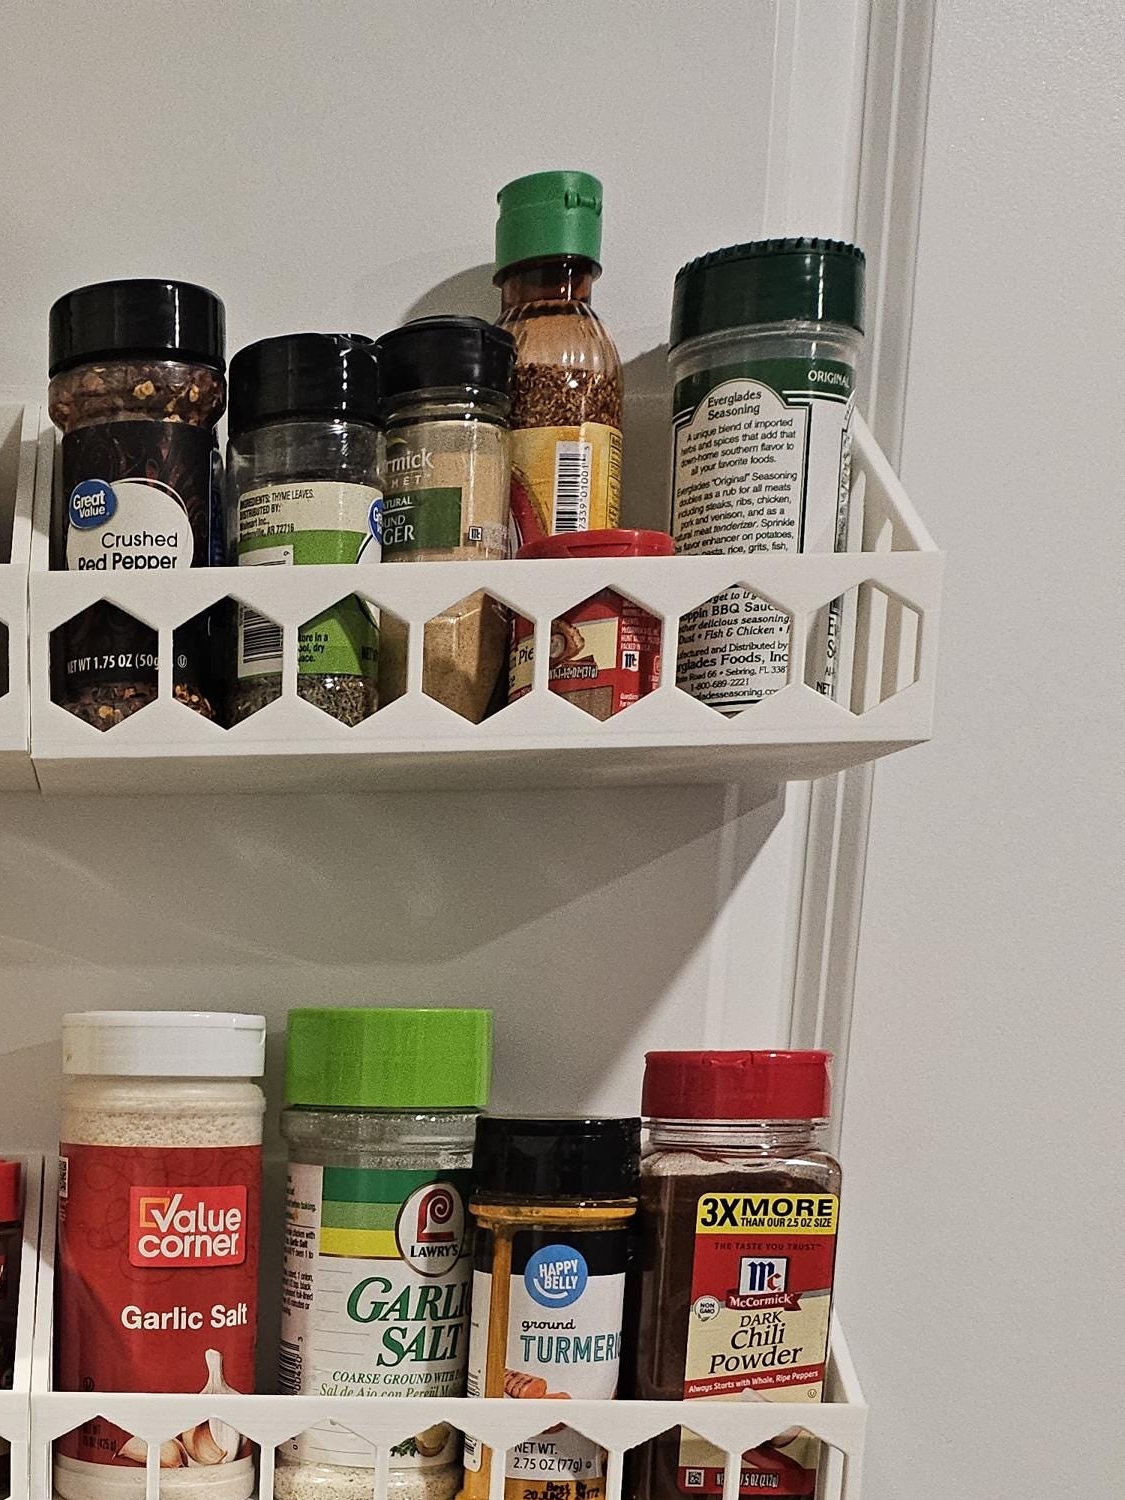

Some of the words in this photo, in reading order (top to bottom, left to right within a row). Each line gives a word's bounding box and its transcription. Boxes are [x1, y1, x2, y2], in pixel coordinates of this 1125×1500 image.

[808, 370, 851, 388] ORIGINAL
[707, 390, 762, 408] Everglades
[708, 404, 760, 421] Seasoning
[754, 419, 793, 429] imported
[721, 445, 758, 458] southern
[761, 442, 784, 452] flavor
[750, 455, 776, 464] foods.
[752, 471, 797, 482] Seasoning
[272, 491, 290, 500] THYME
[292, 490, 314, 500] LEAVES.
[765, 484, 791, 492] meats
[73, 490, 105, 508] Great
[79, 505, 105, 517] Value
[713, 520, 759, 533] tenderizer.
[761, 519, 795, 529] Sprinkle
[102, 533, 178, 548] Crushed
[79, 554, 107, 570] Red
[112, 553, 177, 570] Pepper
[712, 604, 740, 615] BBQ
[698, 618, 738, 629] delicious
[737, 626, 774, 636] Chicken
[729, 640, 775, 652] Distributed
[78, 658, 90, 671] WT
[94, 656, 115, 668] 1.75
[118, 654, 132, 668] OZ
[720, 653, 765, 666] Foods,
[151, 1194, 241, 1232] Value
[701, 1198, 739, 1226] 3X
[742, 1198, 834, 1216] MORE
[741, 1218, 765, 1228] THAN
[767, 1218, 786, 1227] OUR
[787, 1217, 800, 1227] 2.5
[802, 1218, 813, 1227] OZ
[814, 1217, 832, 1227] SIZE
[138, 1232, 238, 1258] corner
[410, 1244, 459, 1258] LAWRY'S
[733, 1242, 762, 1250] TASTE
[766, 1242, 783, 1250] YOU
[539, 1260, 578, 1276] HAPPY
[544, 1274, 578, 1289] BELLY
[347, 1277, 470, 1323] GARLI
[730, 1296, 791, 1307] McCormick
[121, 1306, 203, 1329] Garlic
[211, 1303, 247, 1327] Salt
[739, 1312, 783, 1328] DARK
[522, 1319, 576, 1331] ground
[731, 1324, 785, 1350] Chili
[377, 1324, 463, 1367] SALT
[709, 1346, 803, 1374] Powder
[332, 1371, 381, 1384] COARSE
[383, 1371, 431, 1384] GROUND
[434, 1372, 455, 1383] WITH
[689, 1383, 712, 1393] Always
[715, 1382, 734, 1391] Starts
[752, 1376, 774, 1385] Whole,
[777, 1373, 791, 1382] Ripe
[792, 1370, 819, 1380] Peppers
[537, 1443, 558, 1454] WT.
[513, 1458, 536, 1469] 2.75
[540, 1459, 555, 1469] OZ
[558, 1457, 582, 1472] (77g)
